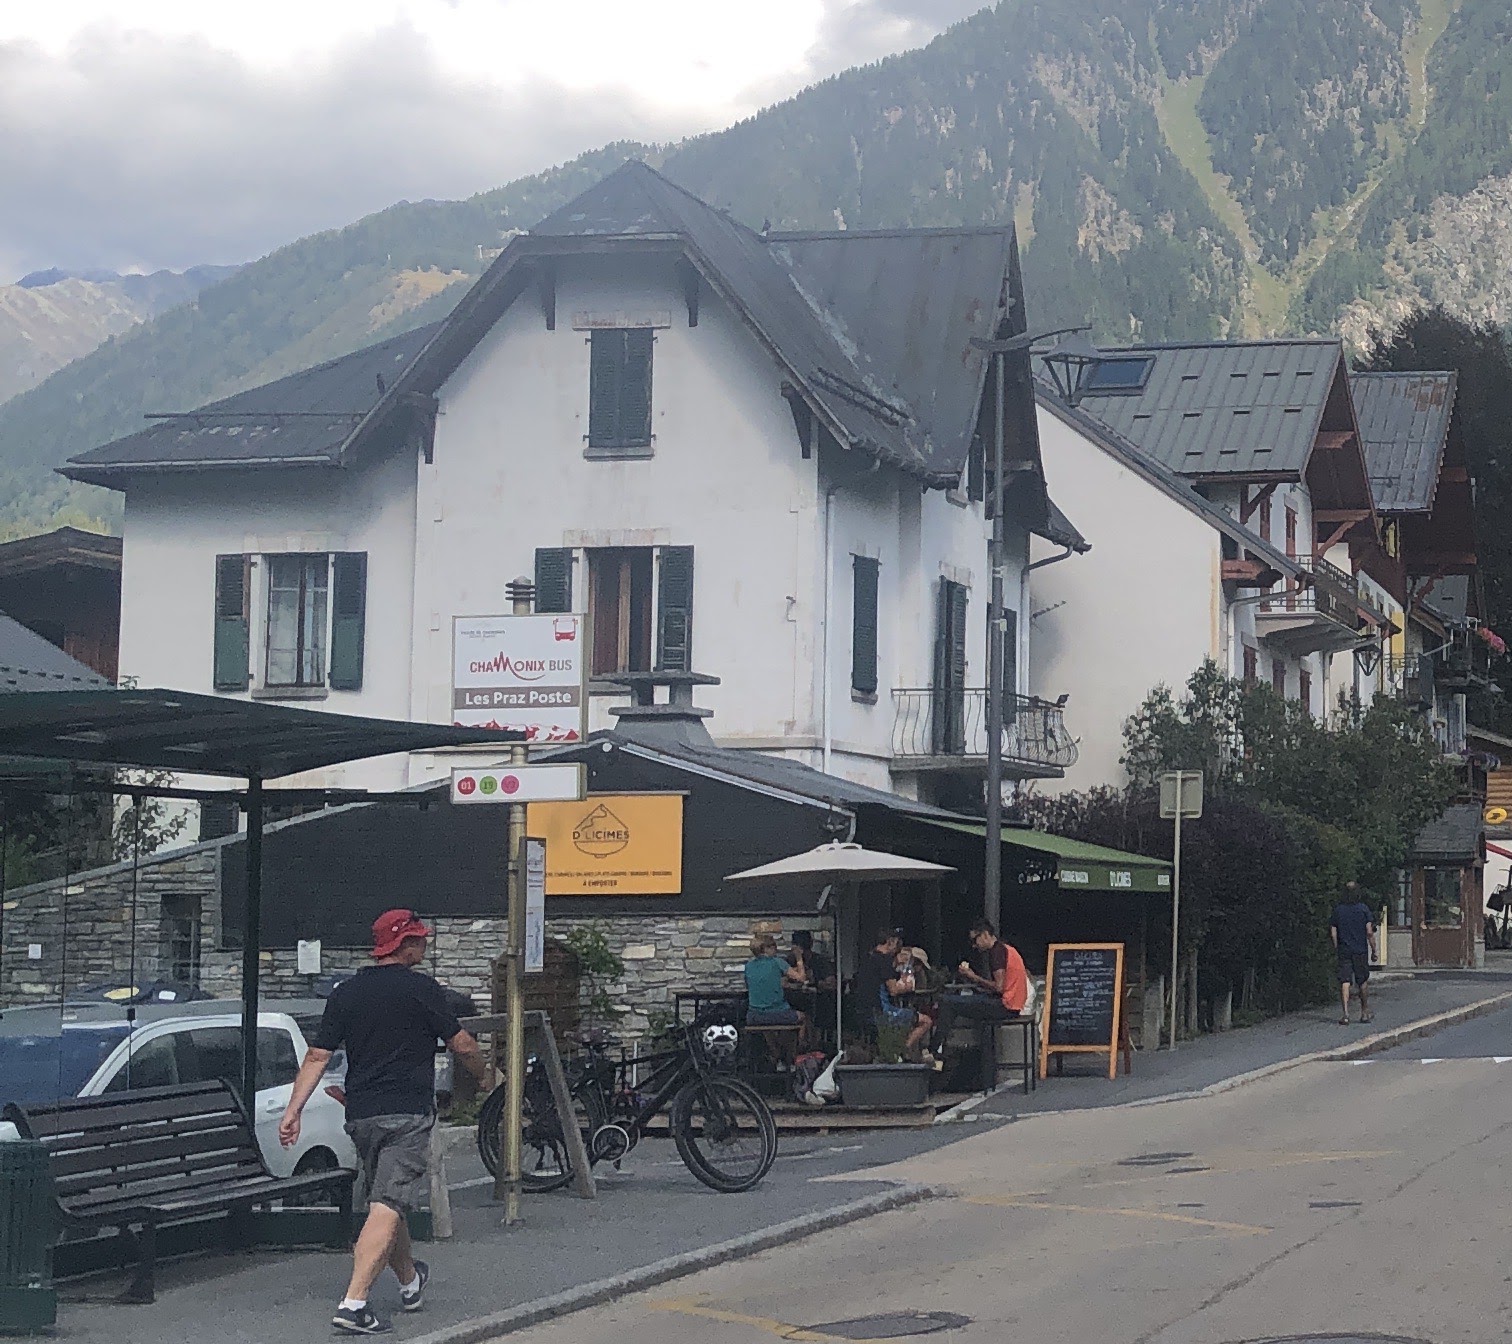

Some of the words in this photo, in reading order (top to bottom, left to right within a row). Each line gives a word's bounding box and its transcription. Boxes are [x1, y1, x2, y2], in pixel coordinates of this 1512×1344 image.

[470, 651, 545, 680] CHAMONIX
[549, 659, 572, 671] BUS
[465, 692, 490, 705] Les
[493, 691, 526, 704] Praz
[529, 690, 572, 704] Poste
[460, 780, 472, 790] 01
